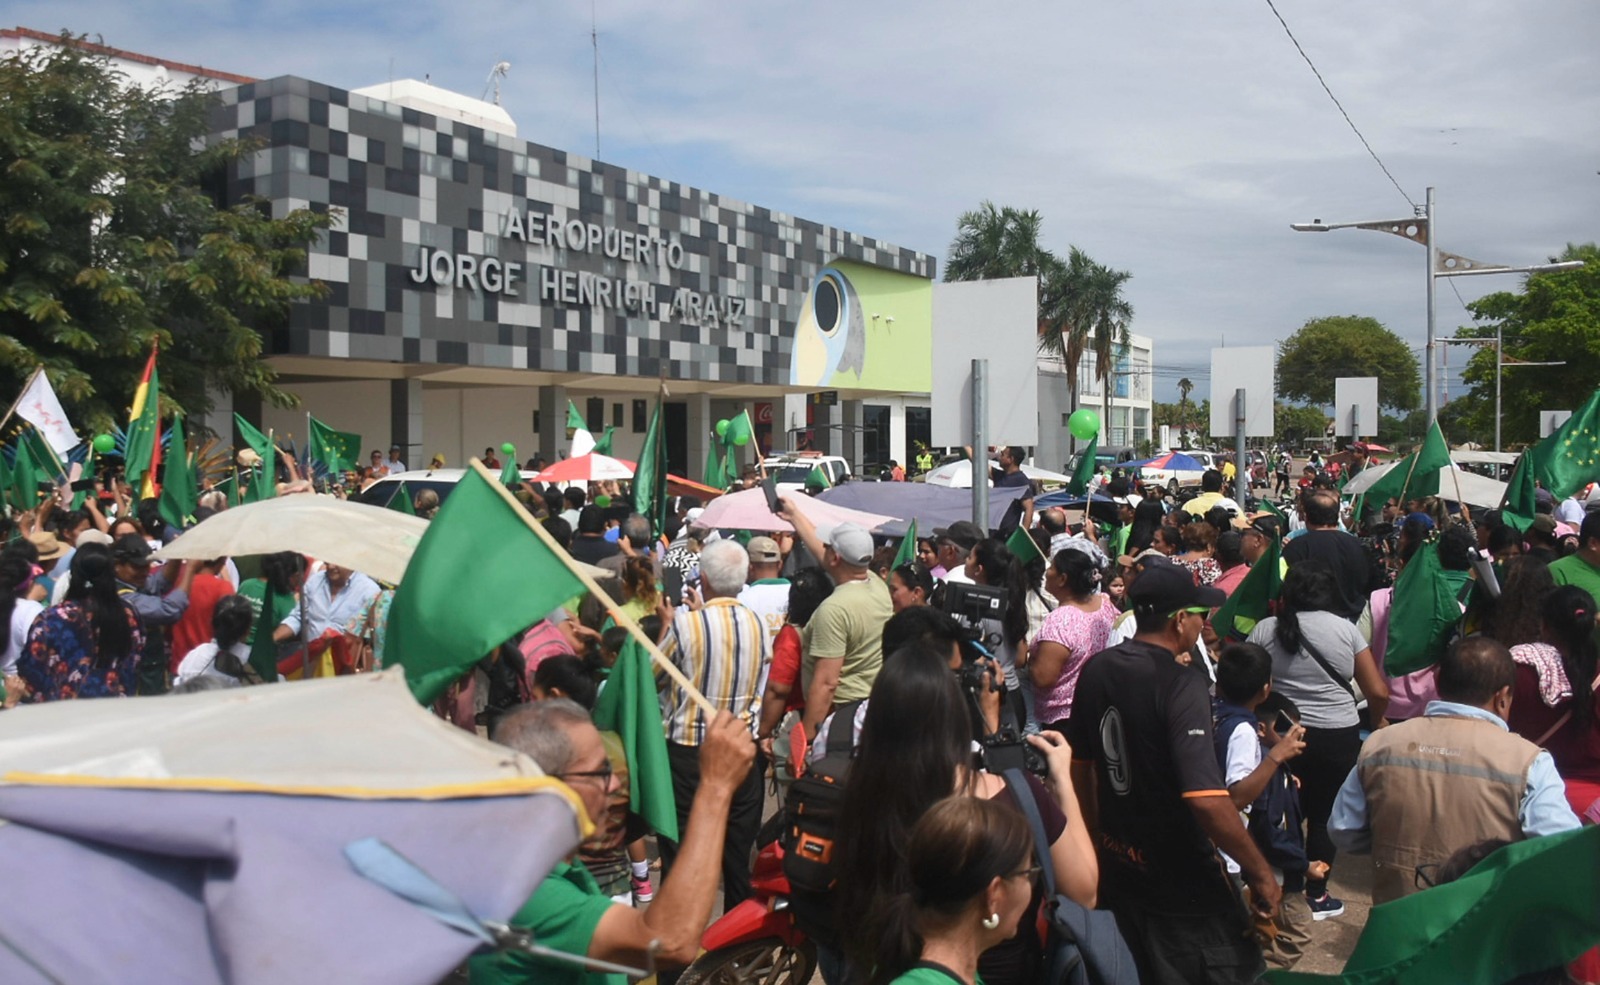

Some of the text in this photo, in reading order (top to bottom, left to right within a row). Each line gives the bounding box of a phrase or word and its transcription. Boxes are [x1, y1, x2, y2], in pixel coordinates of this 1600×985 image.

[503, 206, 684, 270] AEROPUERTO
[410, 246, 746, 330] JORGE HENRICH ARAUZ
[1099, 705, 1132, 796] 9
